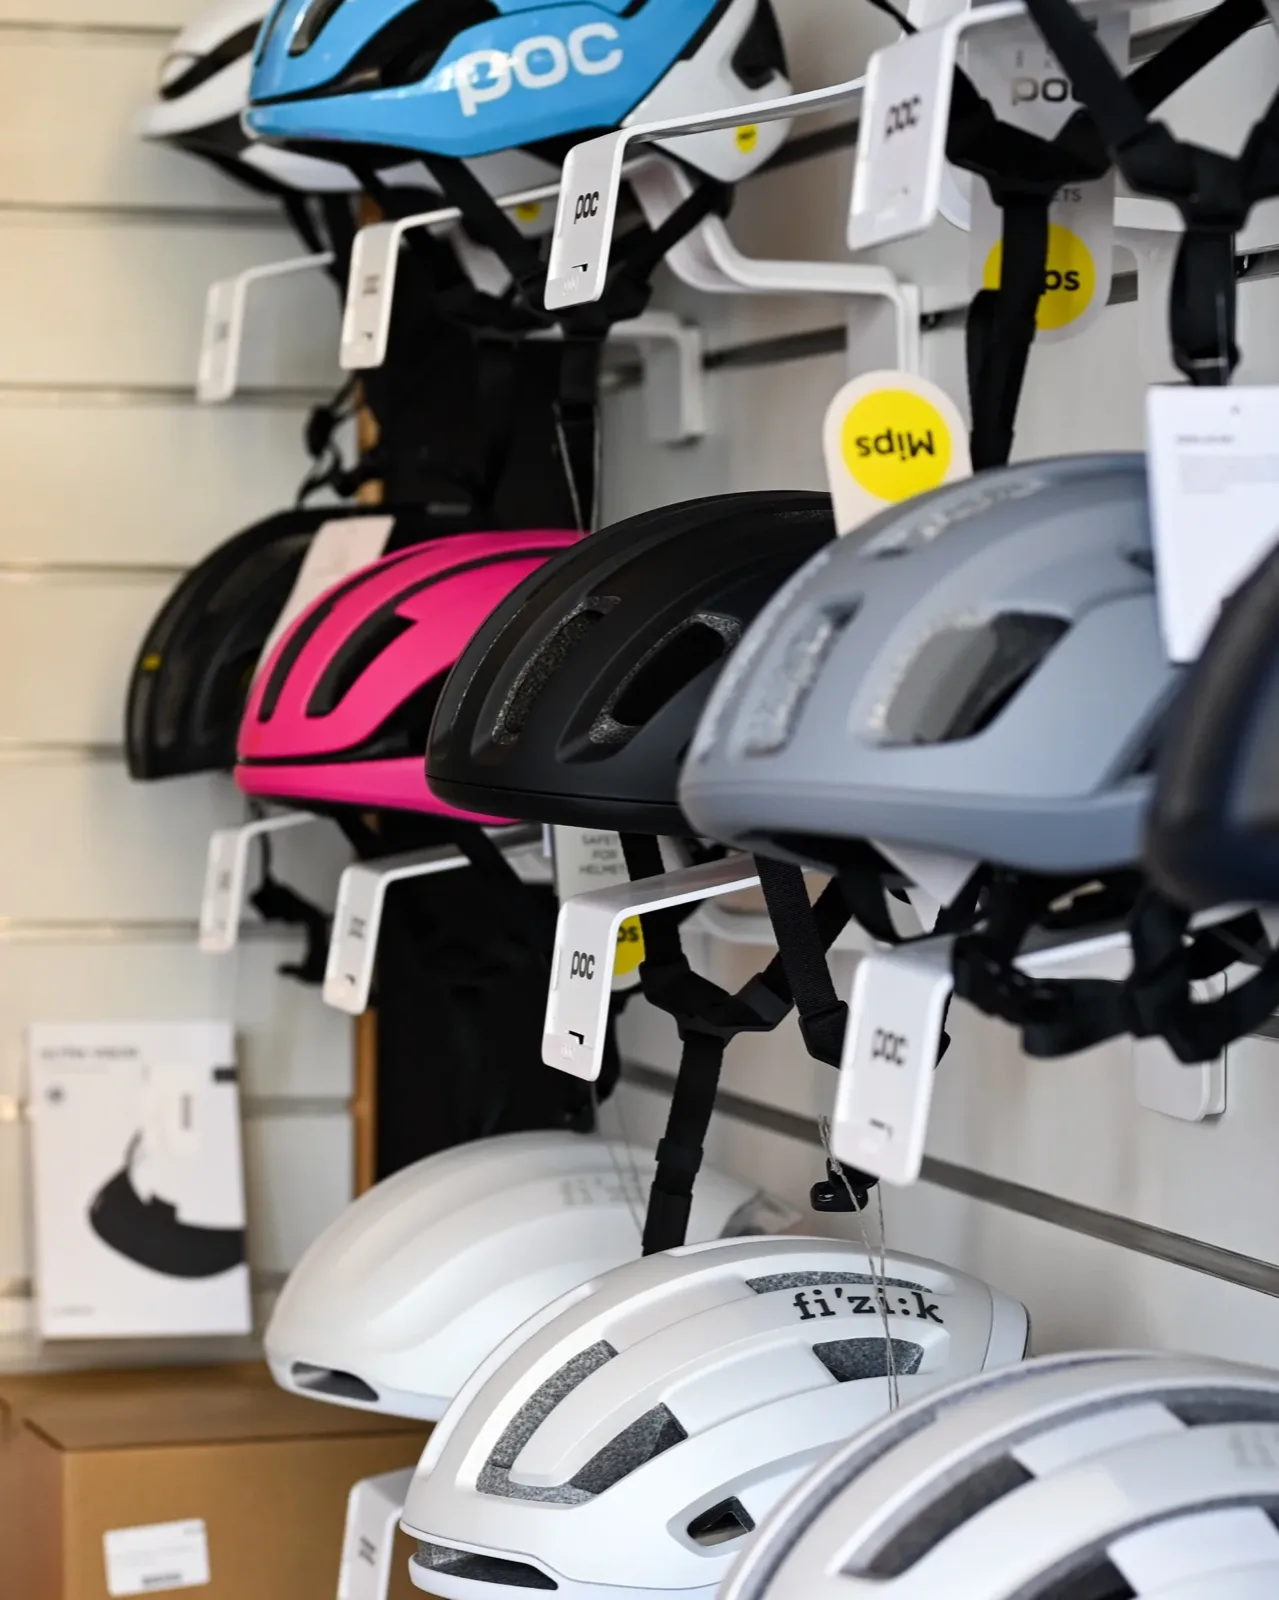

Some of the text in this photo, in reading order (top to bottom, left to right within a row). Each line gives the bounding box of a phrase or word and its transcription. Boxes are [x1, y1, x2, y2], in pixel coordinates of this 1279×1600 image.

[454, 22, 624, 117] poc
[1011, 77, 1078, 107] po
[573, 190, 599, 225] poc
[1044, 269, 1080, 293] ps
[855, 428, 934, 461] Mips
[581, 833, 620, 846] SAFET
[578, 864, 626, 875] HELMET
[570, 951, 596, 979] poc
[793, 1287, 944, 1324] fi'zi:k
